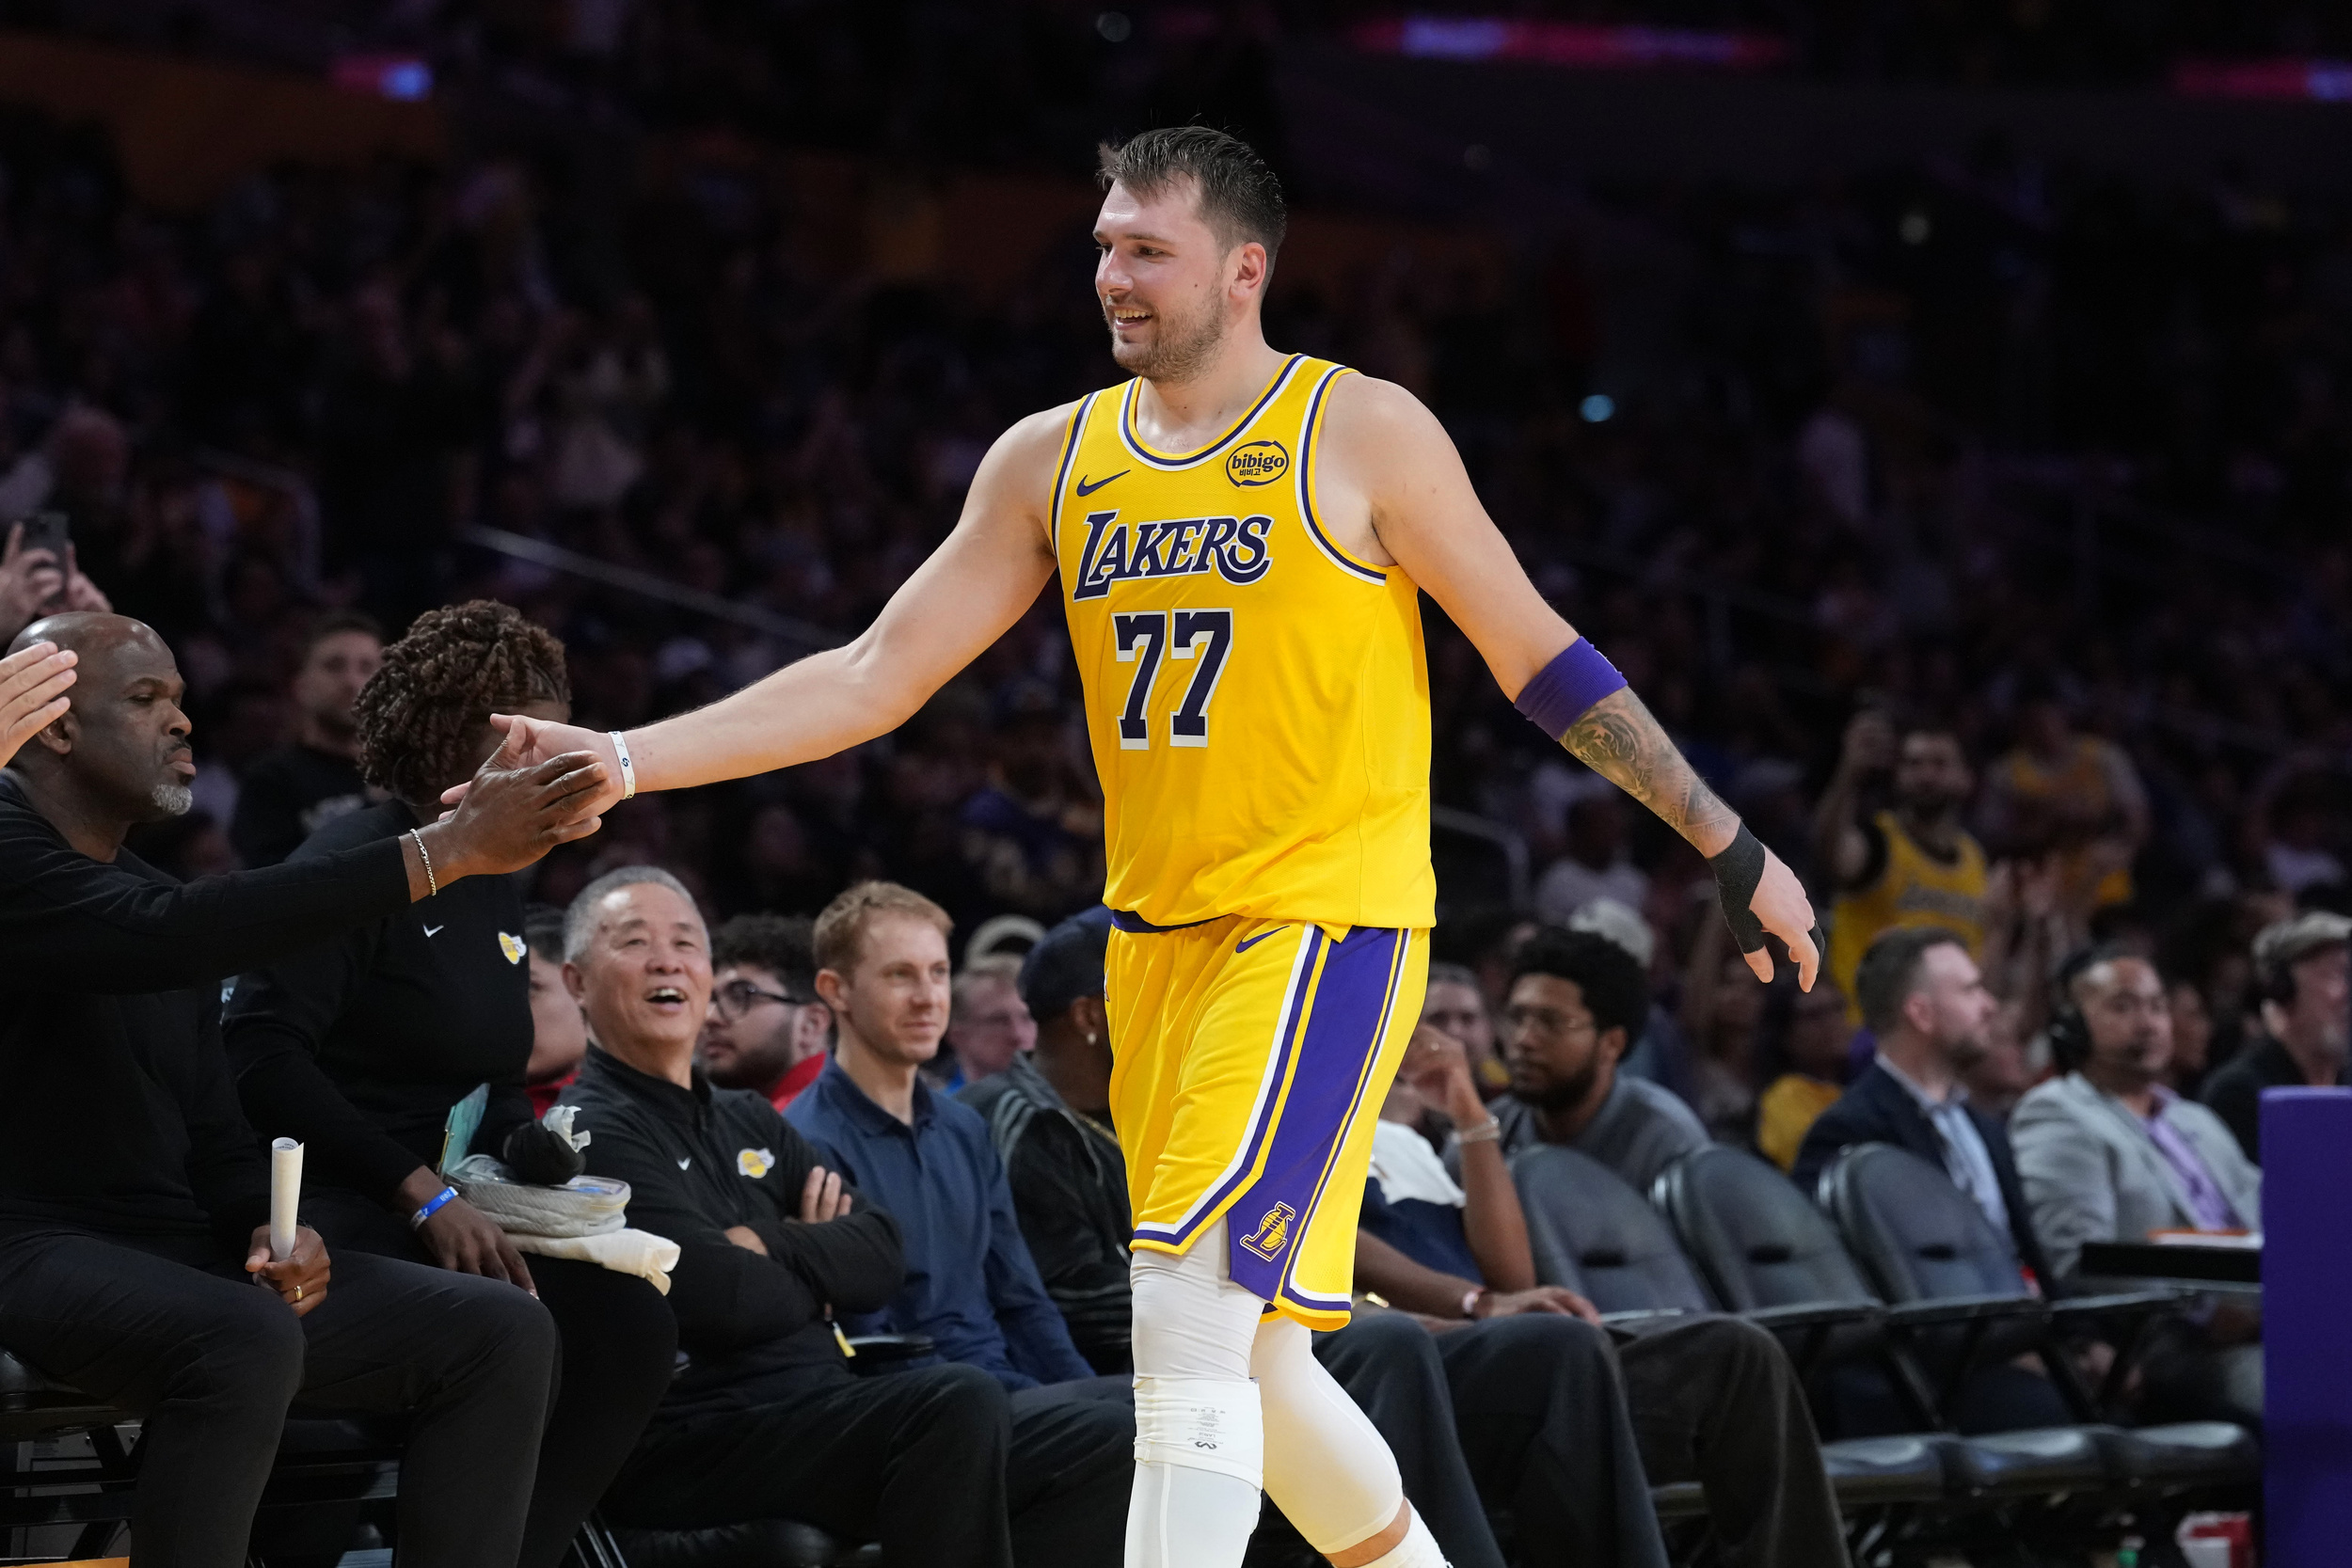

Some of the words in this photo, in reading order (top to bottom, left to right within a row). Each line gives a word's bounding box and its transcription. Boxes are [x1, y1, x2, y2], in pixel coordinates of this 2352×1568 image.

[1232, 452, 1285, 472] bibigo
[1073, 509, 1275, 603] LAKERS
[1111, 609, 1233, 750] 77
